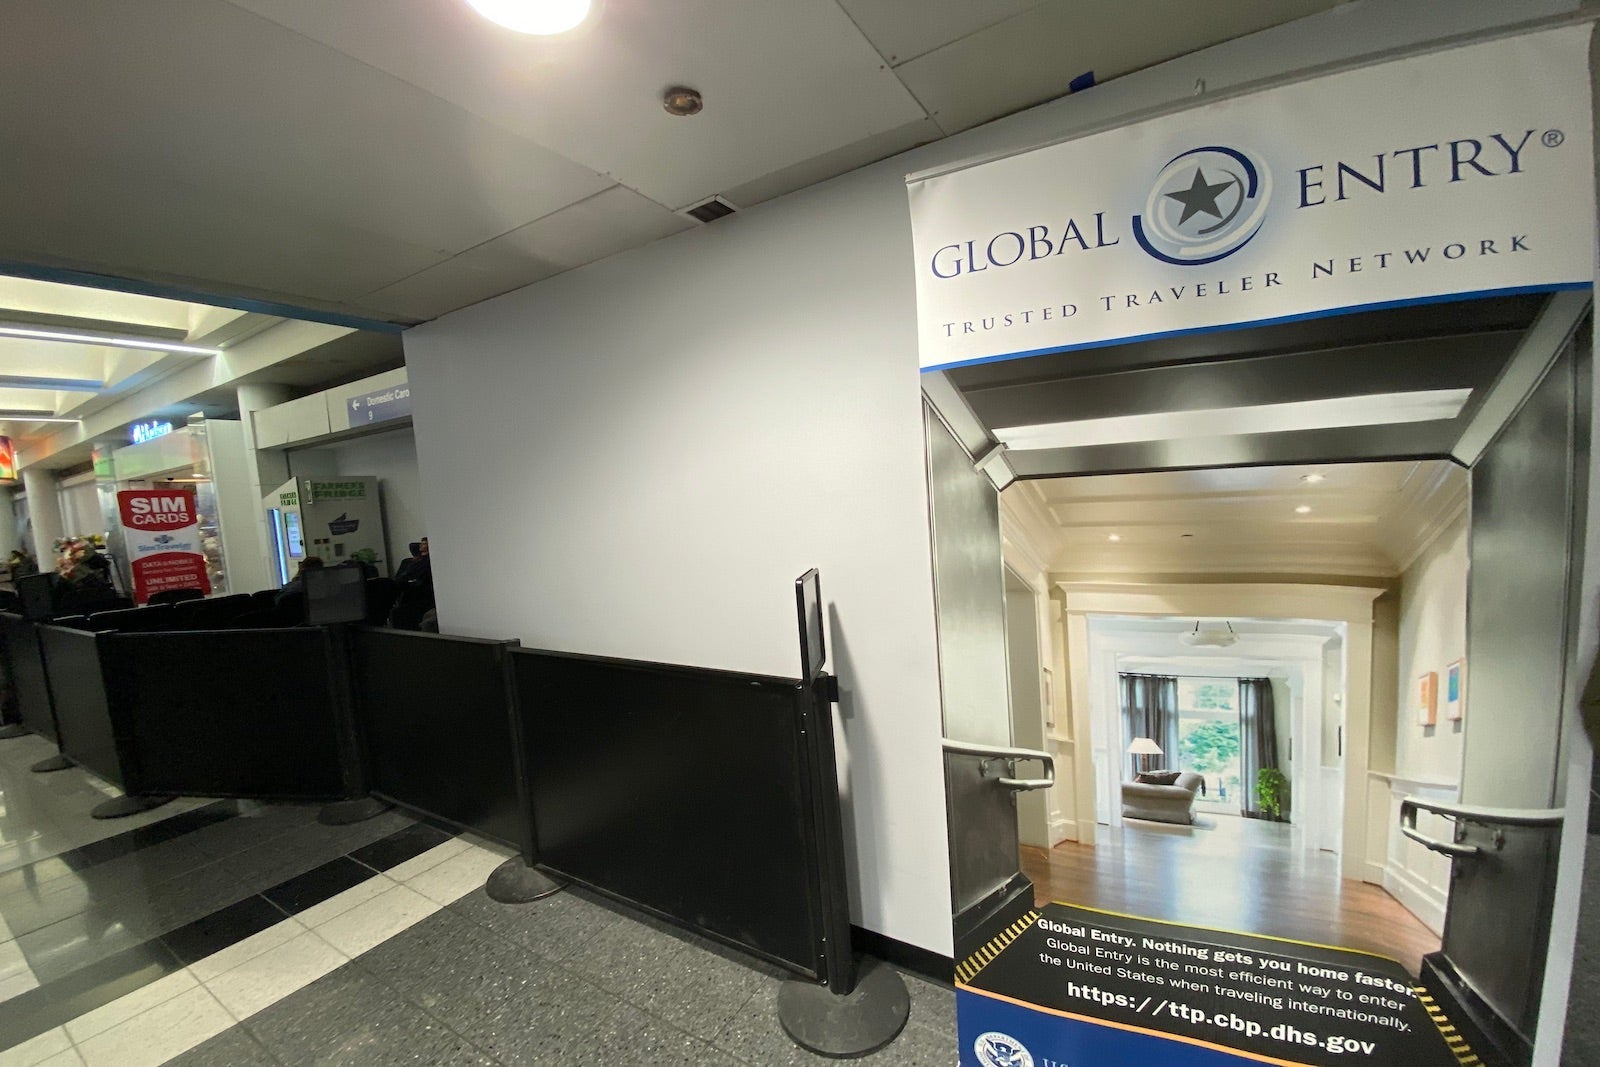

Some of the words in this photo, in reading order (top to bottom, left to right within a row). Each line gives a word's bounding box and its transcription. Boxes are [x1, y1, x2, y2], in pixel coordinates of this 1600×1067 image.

[931, 211, 1120, 279] GLOBAL
[943, 304, 1078, 337] TRUSTED
[1100, 272, 1283, 311] TRAVELER
[1312, 234, 1531, 279] NETWORK
[368, 410, 374, 421] 9
[130, 496, 187, 514] SIM
[132, 513, 190, 525] CARDS
[145, 573, 198, 586] UNLIMITED
[1037, 918, 1086, 938] Global
[1091, 928, 1137, 948] Entry.
[1142, 937, 1208, 960] Nothing
[1213, 950, 1253, 965] gets
[1259, 957, 1291, 972] you
[1297, 962, 1349, 981] home
[1355, 972, 1417, 998] faster.
[1039, 952, 1062, 966] the
[1066, 958, 1111, 975] United
[1116, 967, 1165, 984] States
[1169, 977, 1209, 993] when
[1214, 984, 1284, 1010] traveling
[1288, 998, 1412, 1033] internationally.
[1046, 937, 1090, 957] Global
[1095, 948, 1132, 964] Entry
[1137, 954, 1150, 966] is
[1154, 958, 1180, 971] the
[1184, 964, 1224, 979] most
[1229, 969, 1294, 991] efficient
[1299, 983, 1331, 999] way
[1335, 988, 1353, 1001] to
[1359, 993, 1406, 1011] enter
[1067, 981, 1376, 1055] https://ttp.cbp.dhs.gov
